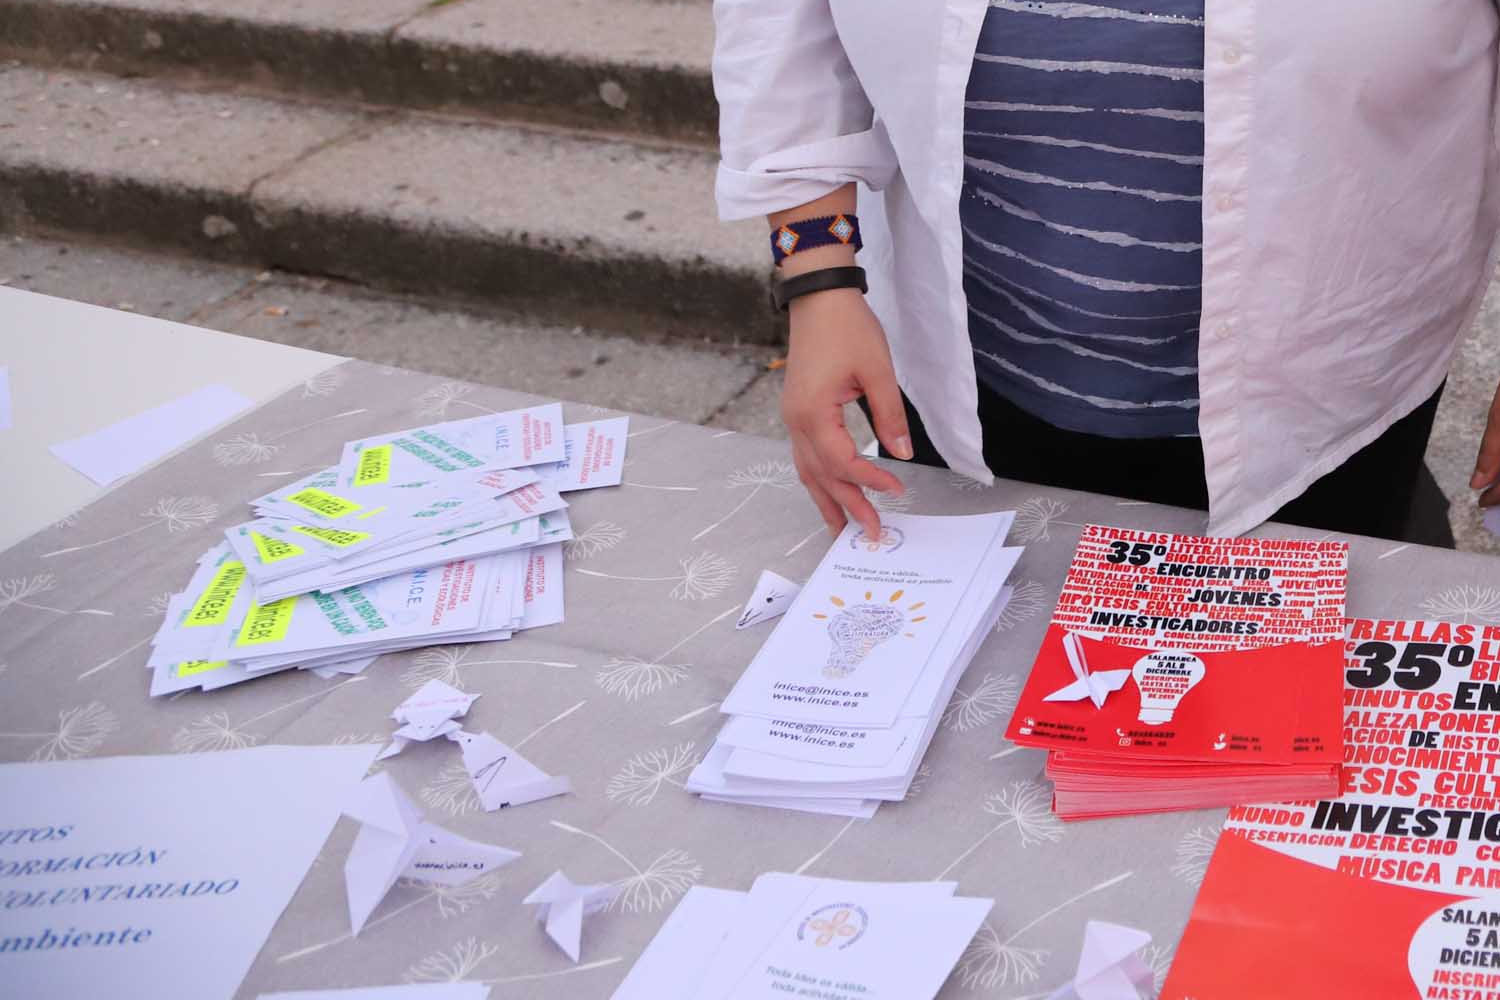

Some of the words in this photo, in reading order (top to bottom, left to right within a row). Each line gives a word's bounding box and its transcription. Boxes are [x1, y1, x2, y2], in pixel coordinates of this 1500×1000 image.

[1169, 543, 1260, 557] LITERATURA
[1098, 560, 1157, 575] MINUTOS
[1156, 563, 1271, 581] ENCUENTRO
[1140, 574, 1205, 588] PONENCIA
[1277, 579, 1316, 591] JUVE
[1094, 586, 1185, 602] CONOCIMIENTO
[1135, 583, 1150, 592] DE
[1187, 586, 1282, 607] JÓVENES
[1145, 600, 1209, 614] CULTURA
[1089, 611, 1259, 635] INVESTIGADORES
[1107, 626, 1156, 637] DERECHO
[1341, 617, 1477, 644] TRELLAS
[1153, 639, 1238, 652] PARTICIPANTES
[1163, 631, 1241, 642] CONCLUSIONES
[1148, 655, 1197, 663] SALAMANCA
[1346, 641, 1475, 691] 35º
[1145, 668, 1193, 677] DICIEMBRE
[773, 681, 870, 698] inice@inice.es
[772, 692, 860, 708] www.inice.es
[1344, 710, 1418, 731] ALEZA
[768, 729, 856, 750] www.inice.es
[1408, 730, 1441, 749] DE
[1226, 805, 1305, 828] MUNDO
[1349, 833, 1459, 857] DERECHO
[0, 846, 168, 877] ORMACIÓN
[1335, 852, 1441, 885] MÚSICA
[0, 927, 153, 952] mbiente
[1465, 927, 1482, 947] 5
